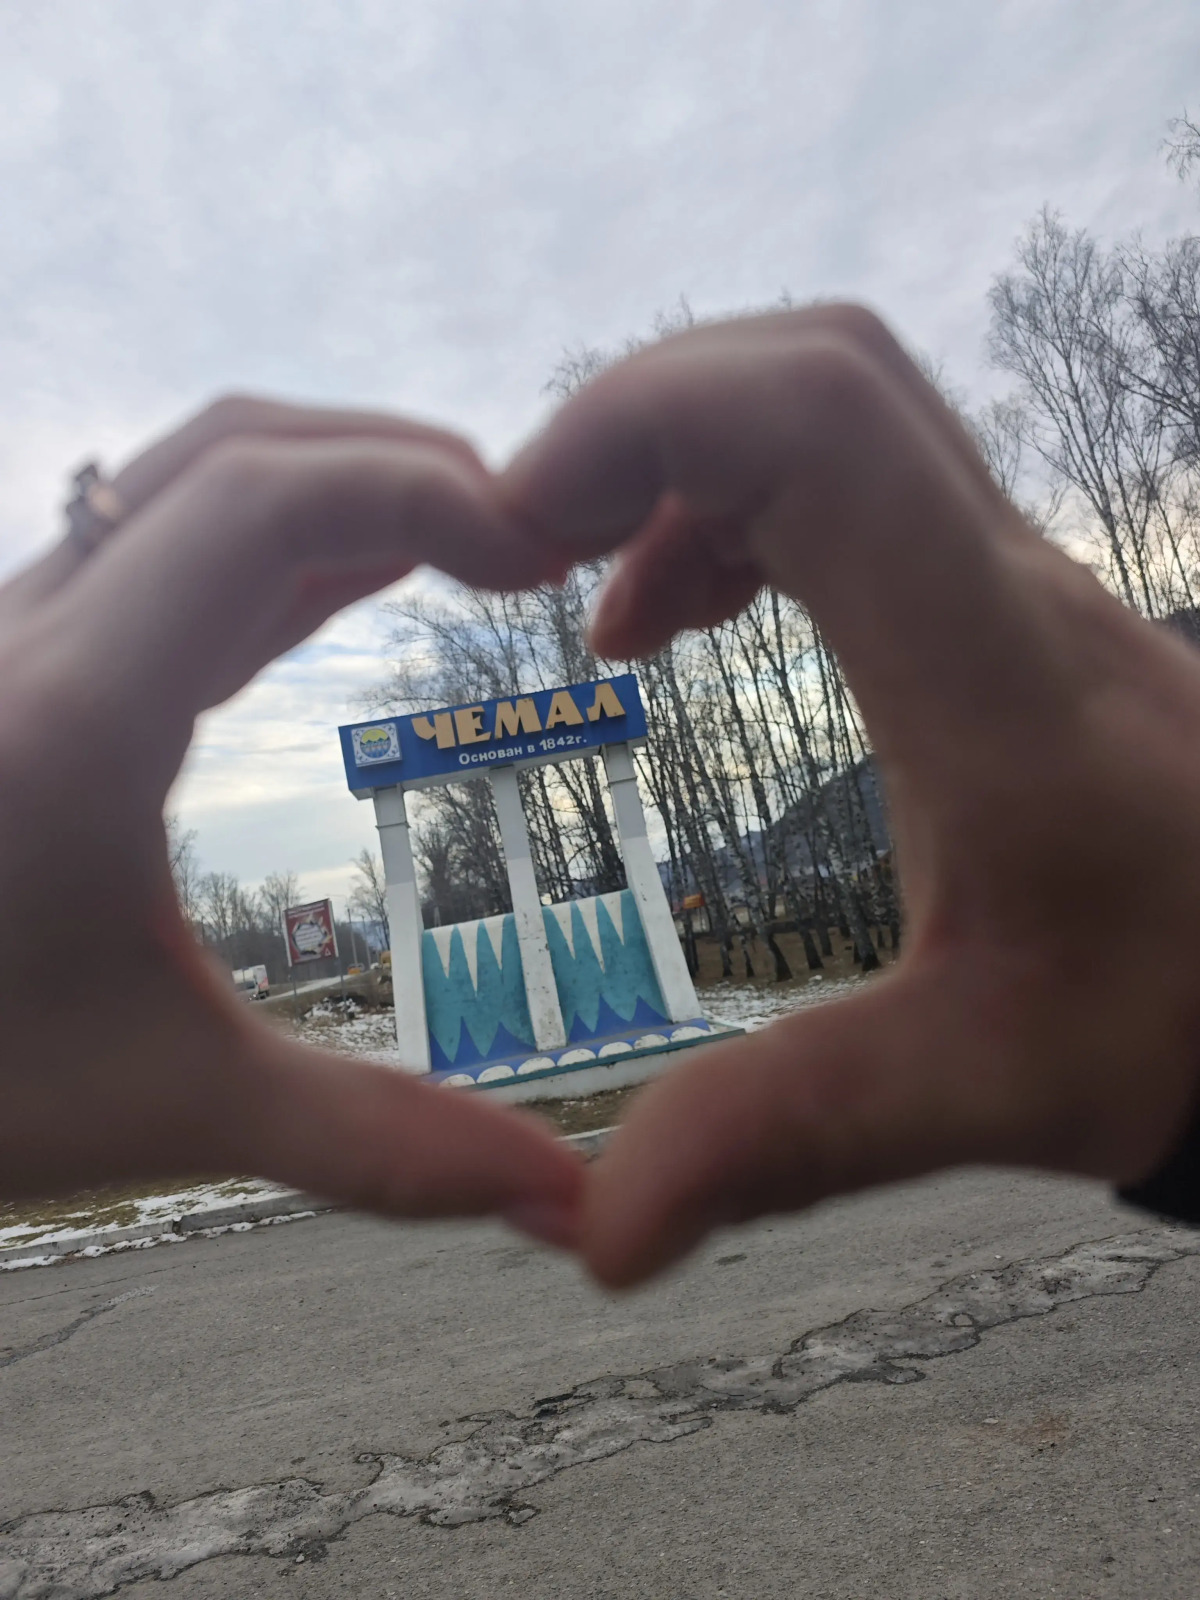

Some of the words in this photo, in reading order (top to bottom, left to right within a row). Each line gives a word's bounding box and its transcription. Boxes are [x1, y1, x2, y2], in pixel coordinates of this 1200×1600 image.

[411, 682, 626, 749] ЧЕМАЛ
[458, 746, 523, 765] Основан
[527, 744, 536, 754] в
[539, 735, 587, 751] 1842г.
